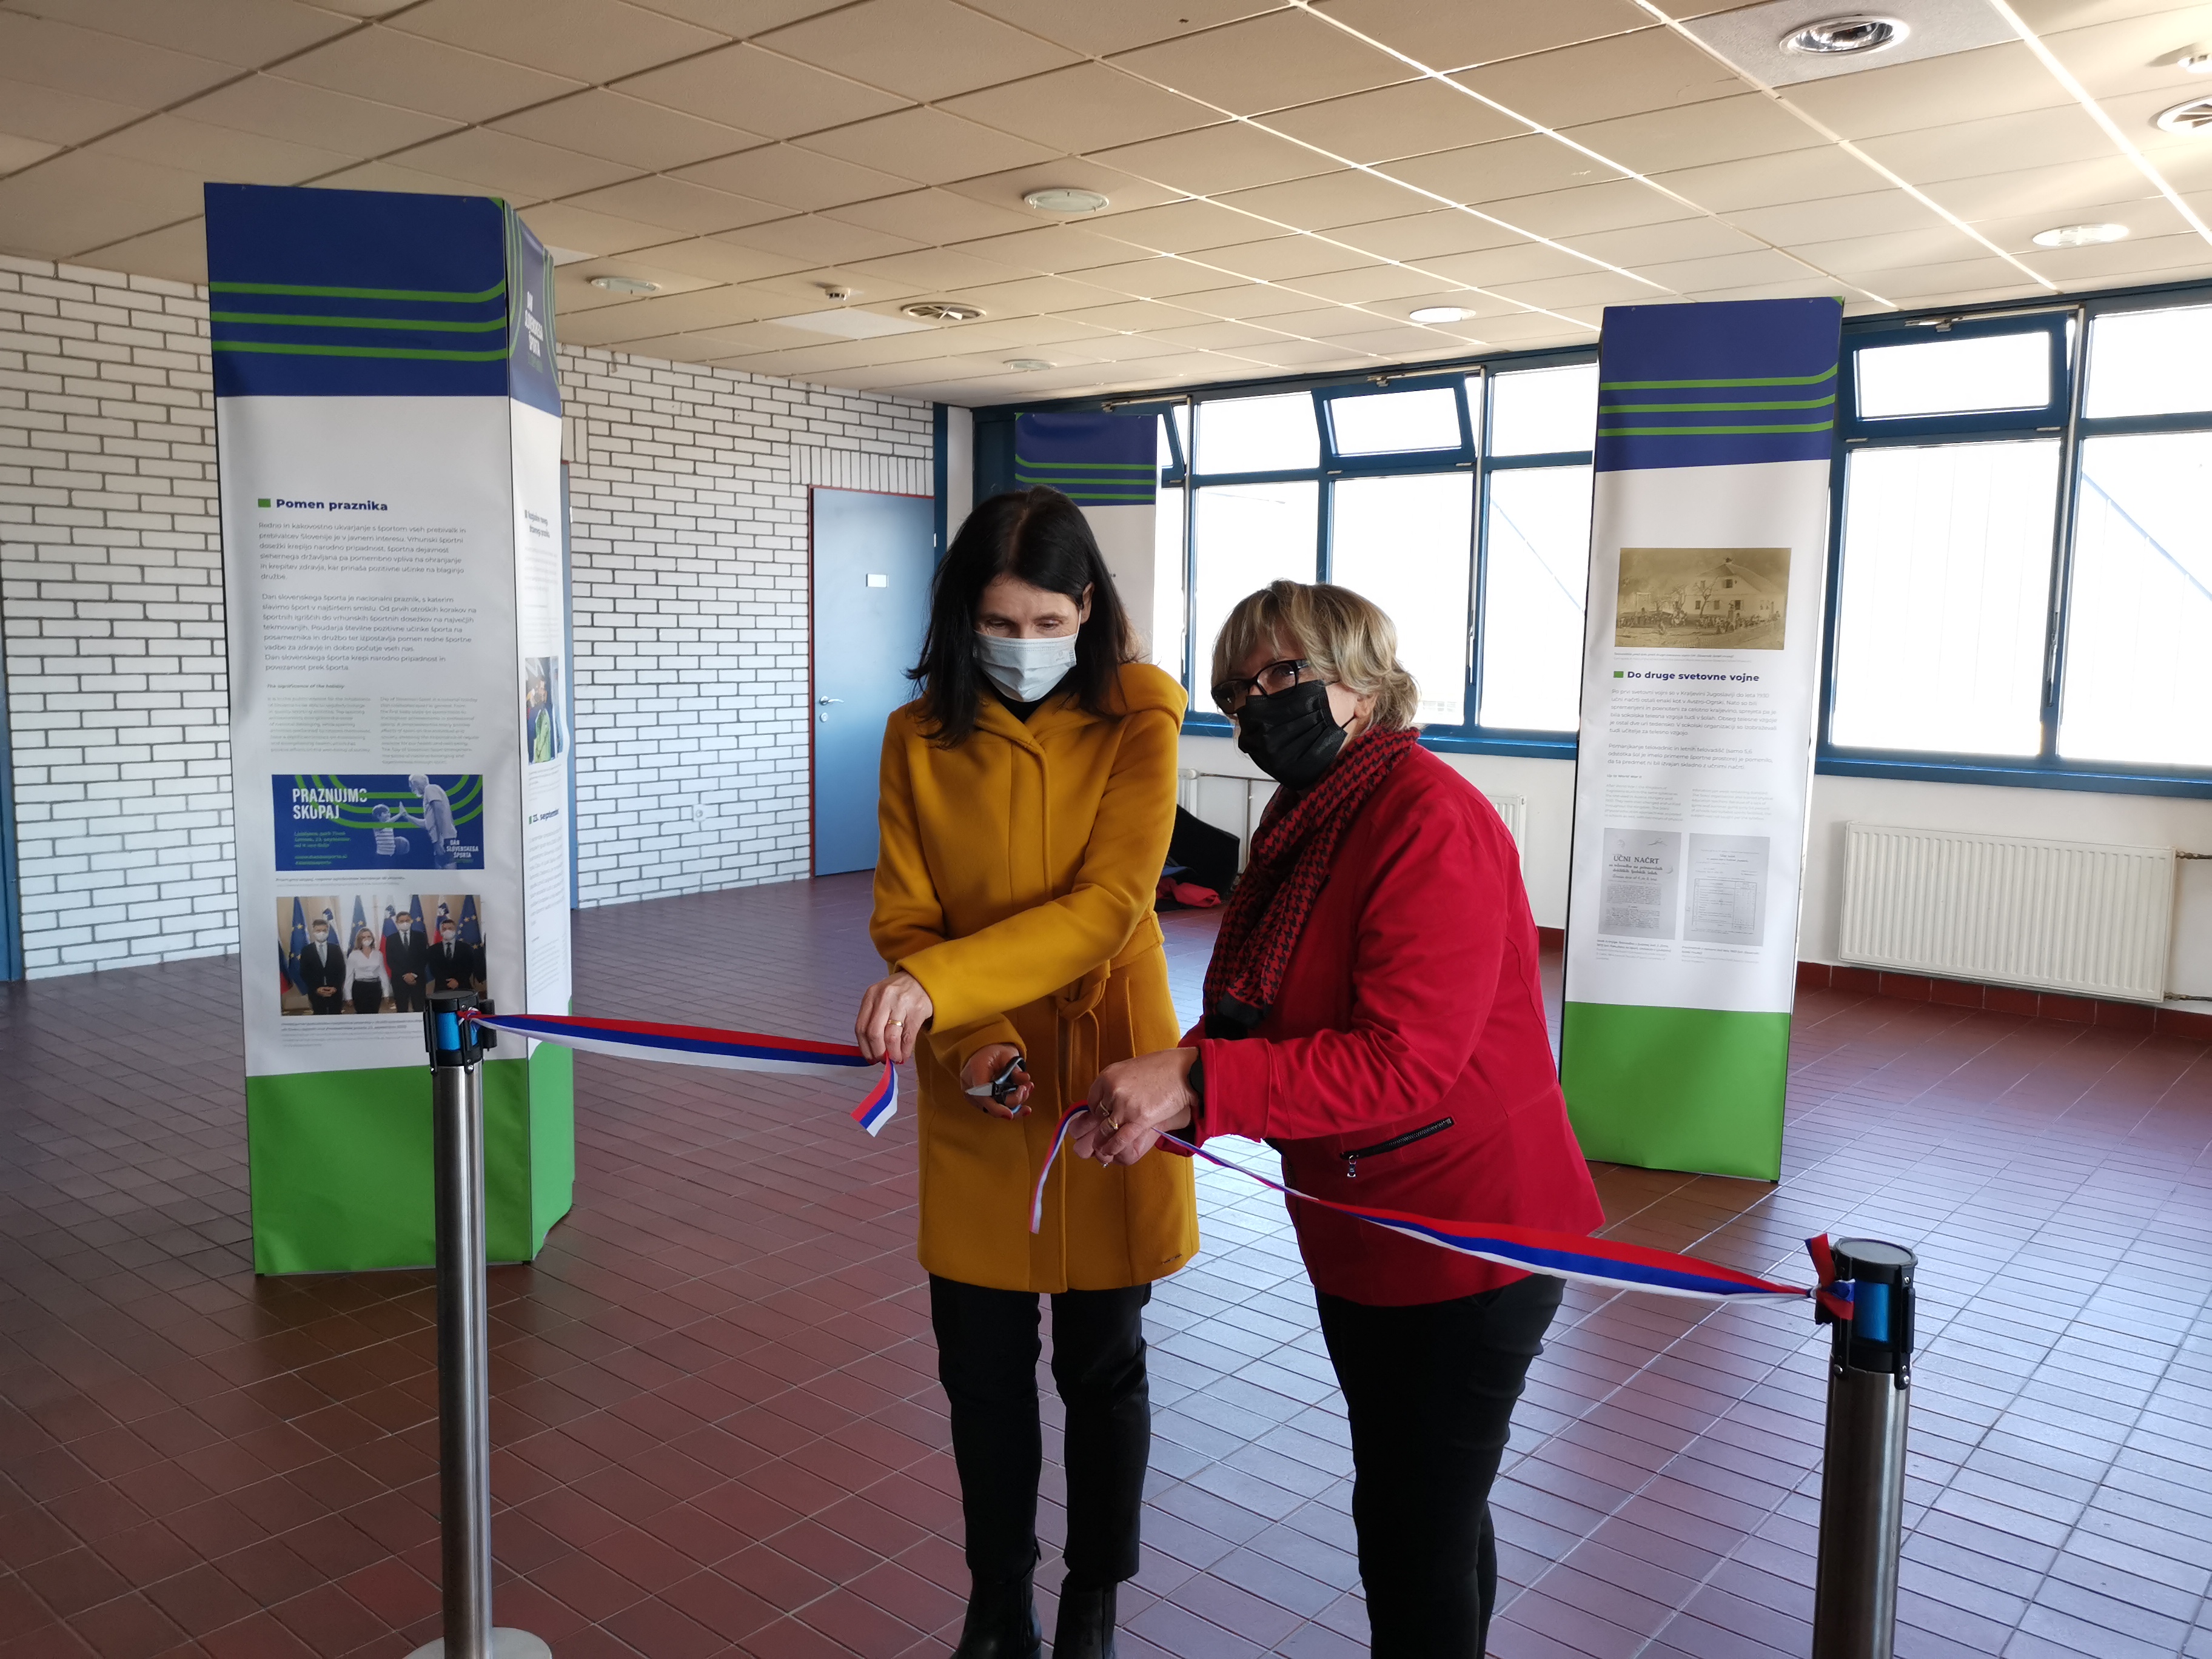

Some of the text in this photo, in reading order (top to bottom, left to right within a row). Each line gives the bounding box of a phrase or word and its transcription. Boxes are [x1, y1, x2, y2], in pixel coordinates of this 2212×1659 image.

[276, 499, 387, 511] Pomen praznika
[1644, 672, 1675, 680] druge
[1729, 673, 1759, 682] vojne
[293, 805, 340, 819] SKUPAJ
